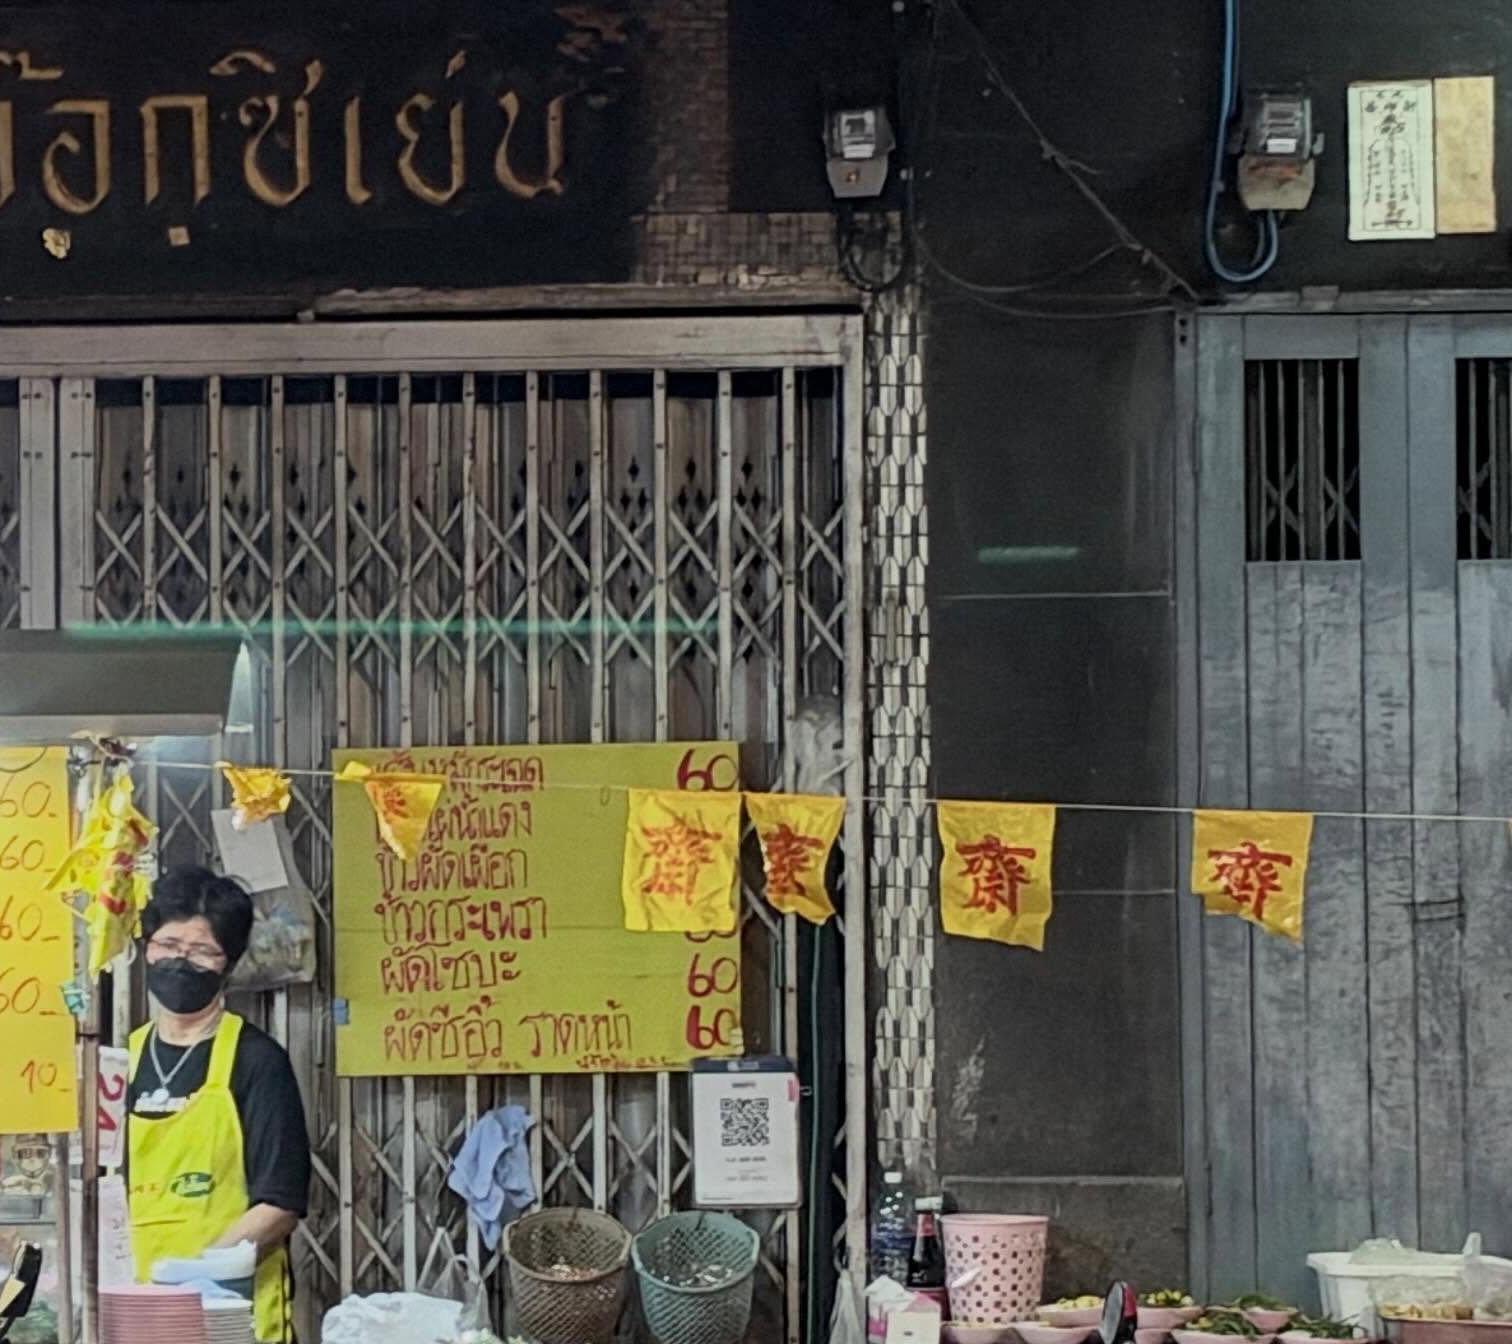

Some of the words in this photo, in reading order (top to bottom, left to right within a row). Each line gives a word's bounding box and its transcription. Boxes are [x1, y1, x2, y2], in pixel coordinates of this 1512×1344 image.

[677, 749, 739, 791] 60
[688, 954, 739, 998] 60
[686, 1005, 738, 1051] 60
